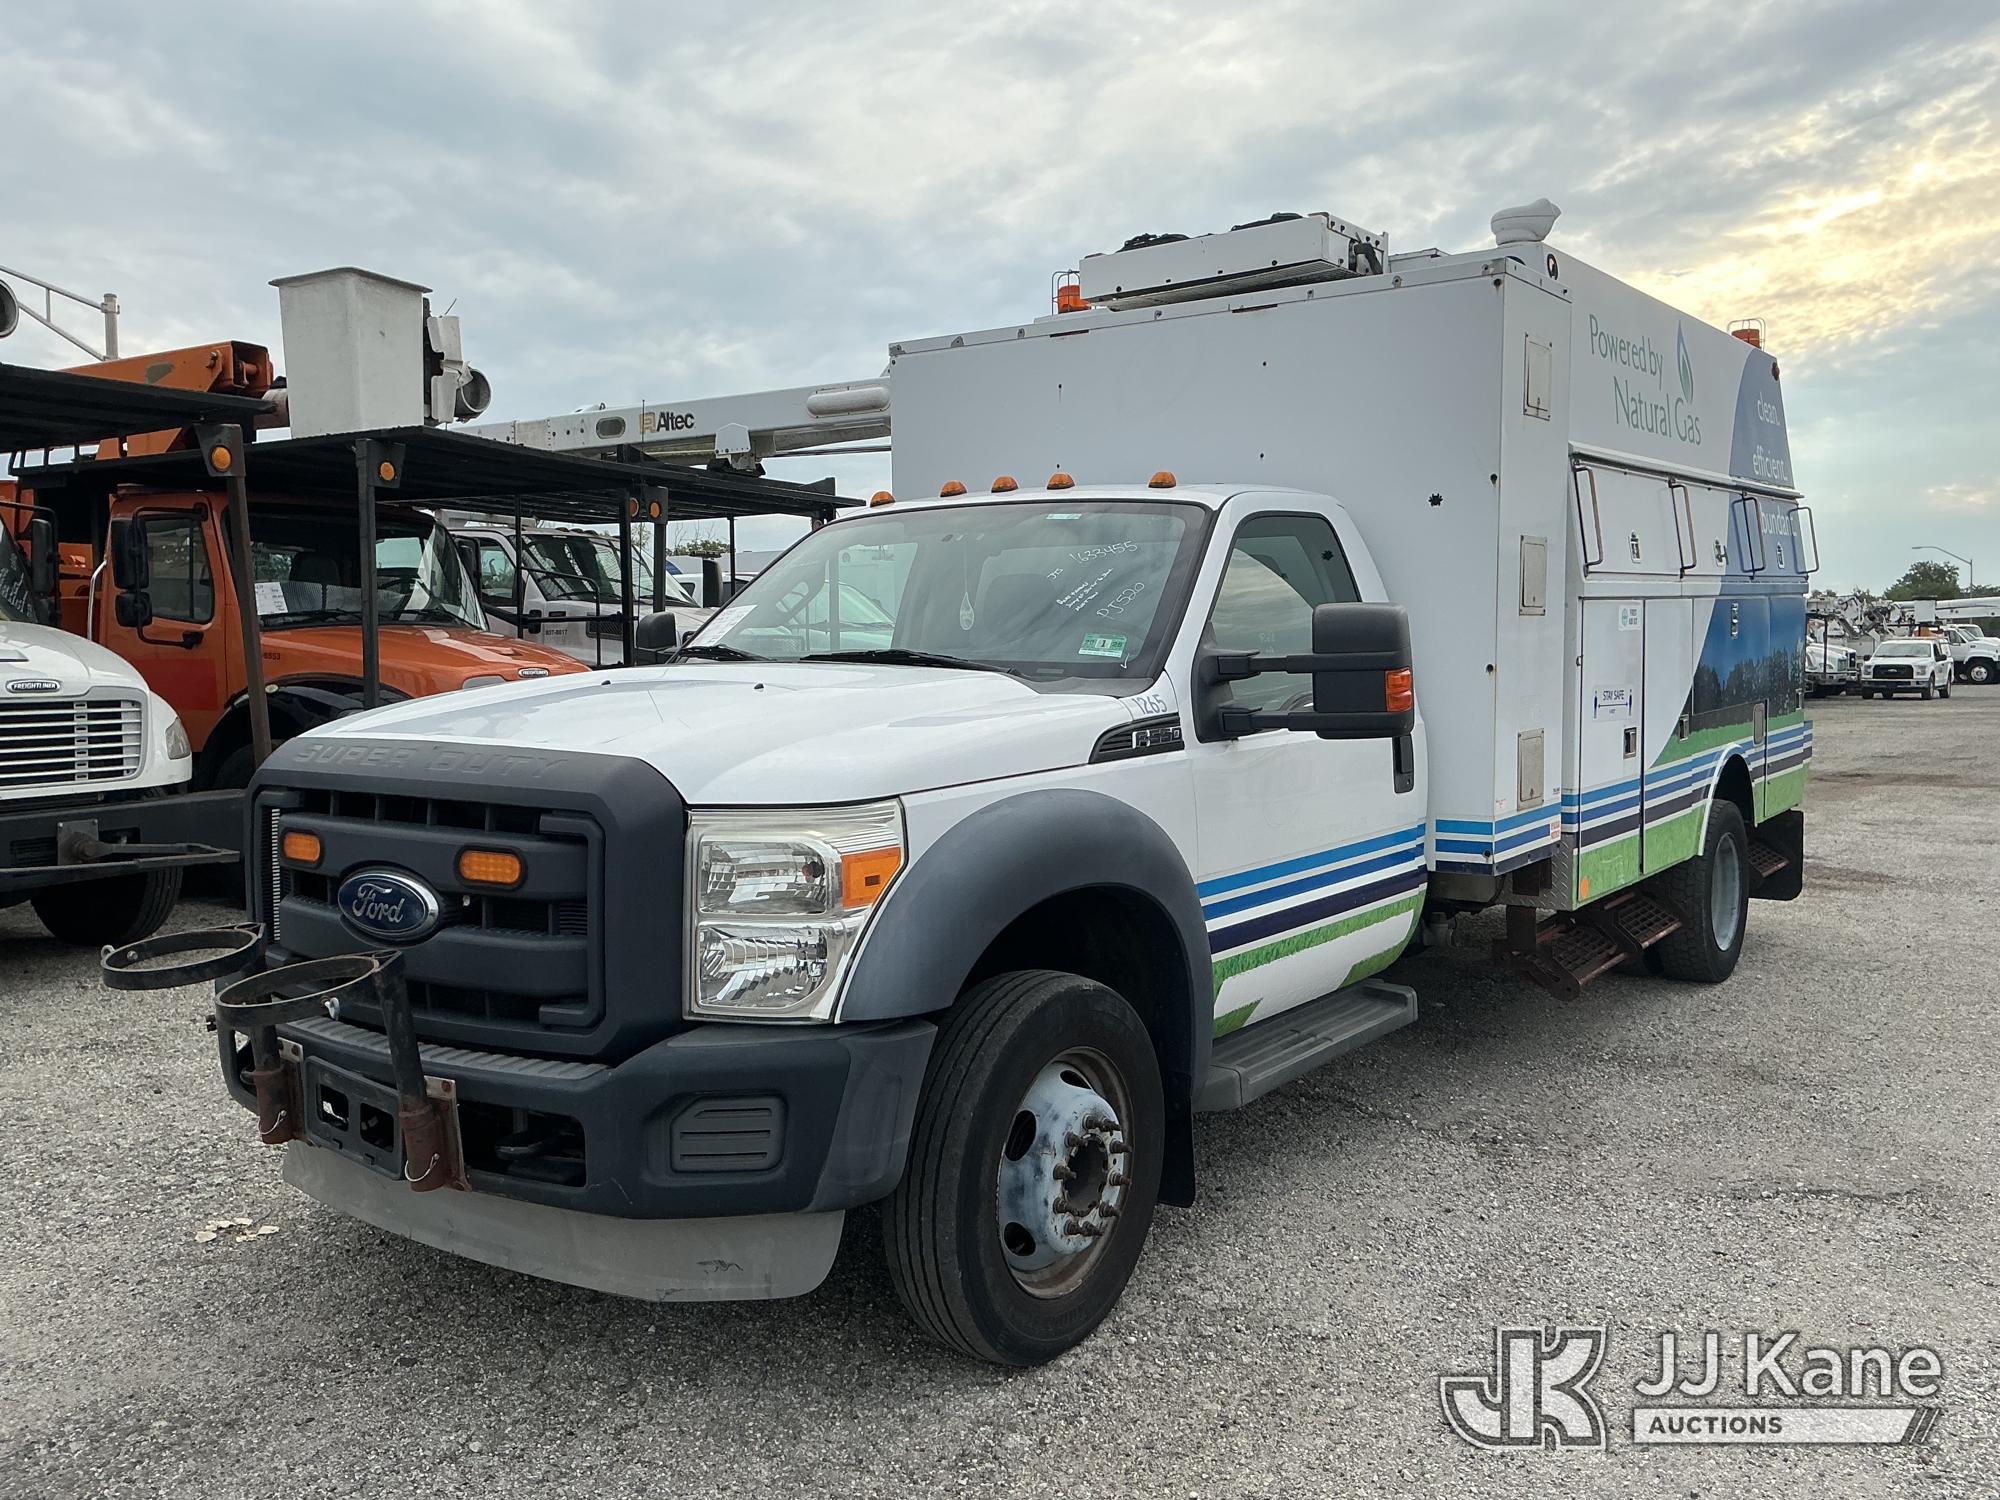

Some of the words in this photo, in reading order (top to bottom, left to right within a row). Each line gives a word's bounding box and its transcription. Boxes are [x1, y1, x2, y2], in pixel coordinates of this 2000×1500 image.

[1589, 313, 1647, 373] Powered
[1647, 337, 1663, 391] by
[656, 411, 695, 432] Altec
[1613, 375, 1672, 438] Natural
[1674, 396, 1702, 446] Gas
[1068, 540, 1138, 564] 1633455
[14, 682, 56, 690] FREIGHTLINER
[1131, 694, 1168, 715] 1265
[294, 742, 417, 768] SUPER
[425, 746, 568, 778] DUTY
[352, 882, 405, 924] Ford
